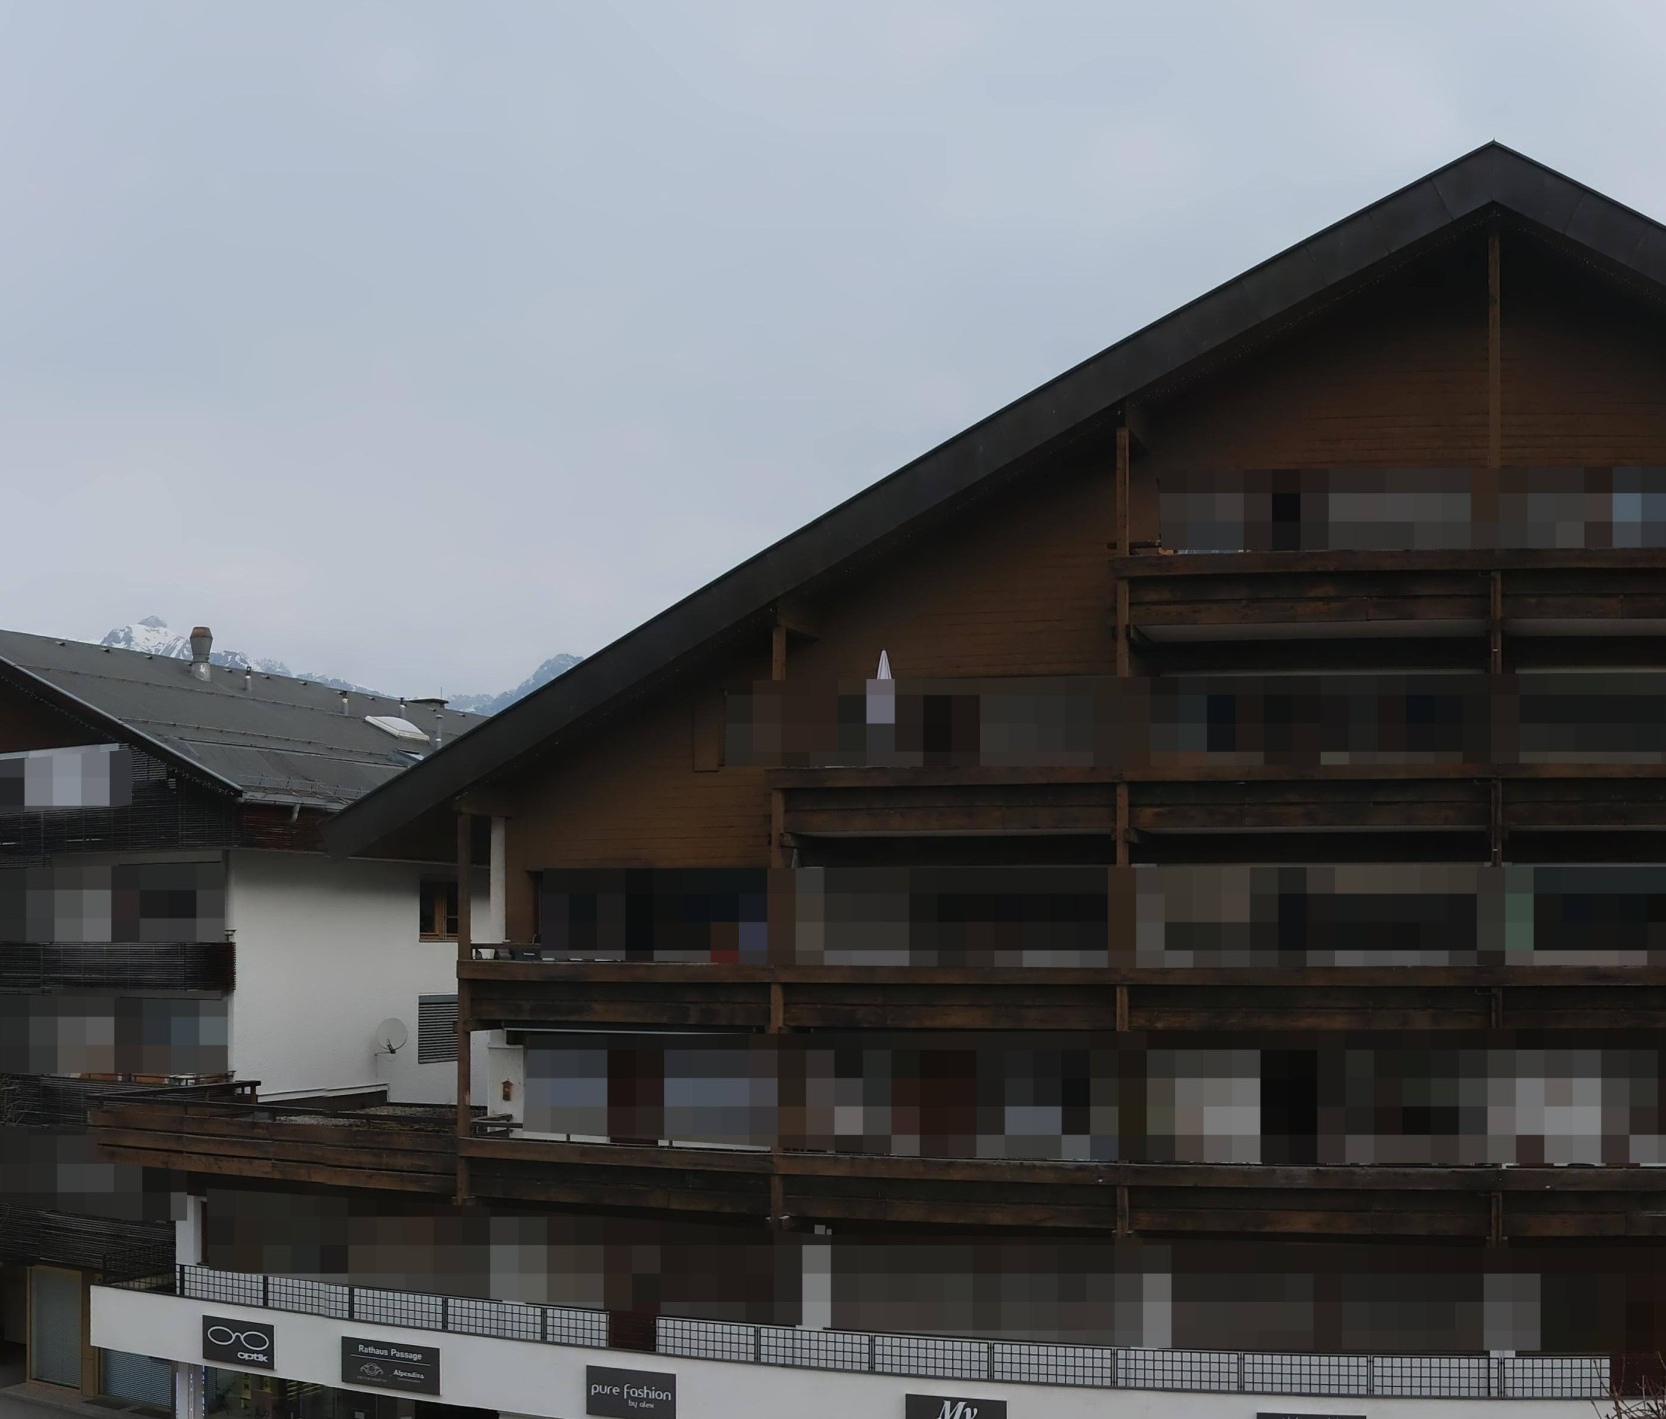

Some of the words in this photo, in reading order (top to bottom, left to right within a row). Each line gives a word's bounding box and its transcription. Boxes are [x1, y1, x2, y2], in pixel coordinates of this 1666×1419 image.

[237, 1351, 270, 1363] optik
[358, 1344, 389, 1357] Rathaus
[390, 1348, 422, 1361] Passage
[591, 1383, 621, 1396] pure
[623, 1383, 672, 1401] fashion
[628, 1399, 638, 1409] by
[639, 1400, 654, 1409] alex
